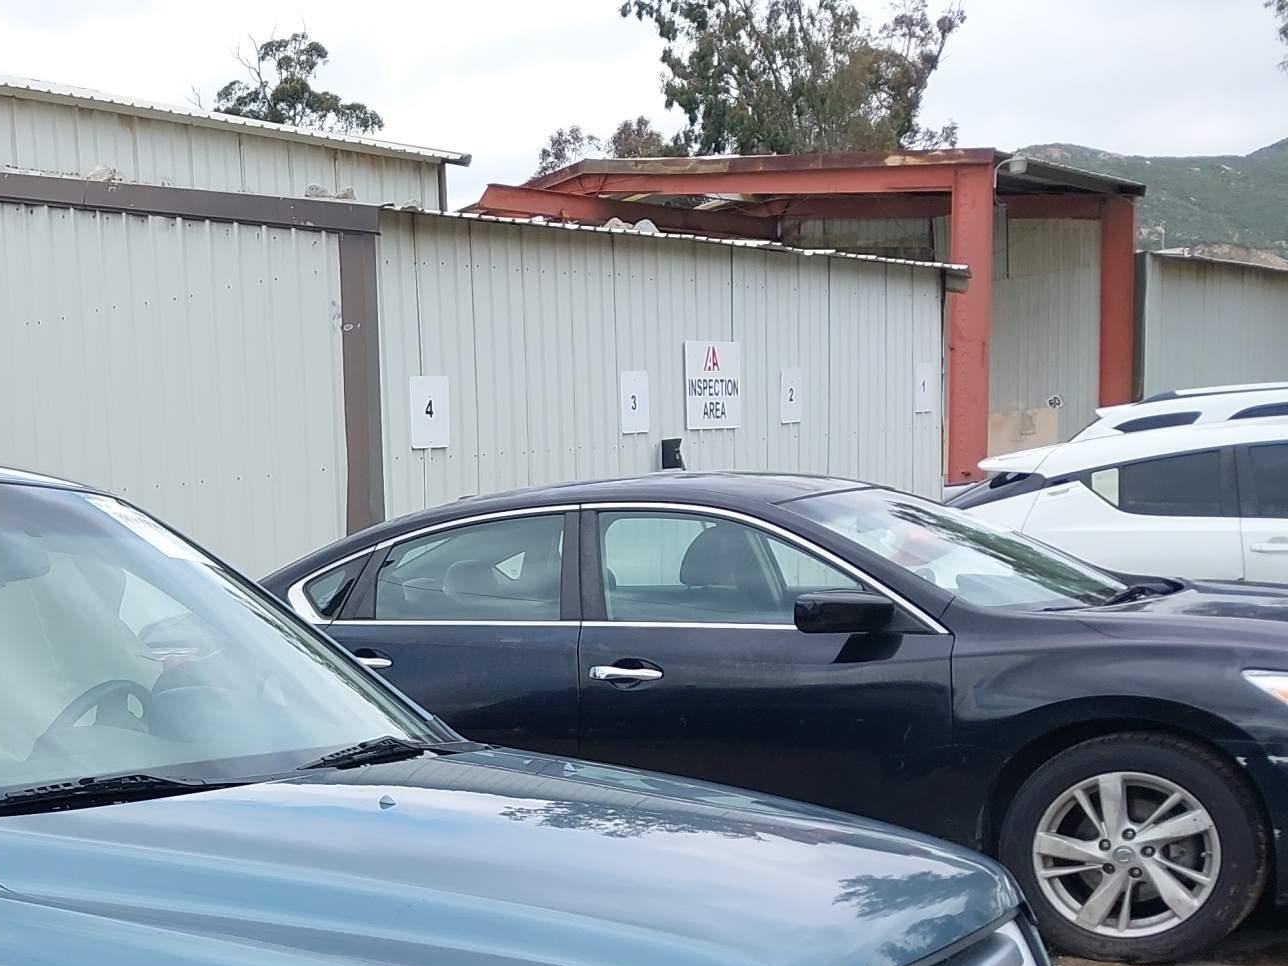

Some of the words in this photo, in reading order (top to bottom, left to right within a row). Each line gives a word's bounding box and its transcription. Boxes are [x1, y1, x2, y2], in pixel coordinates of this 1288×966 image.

[688, 379, 739, 397] INSPECTION
[788, 387, 794, 402] 2
[425, 399, 434, 418] 4
[631, 395, 637, 411] 3
[703, 401, 727, 419] AREA
